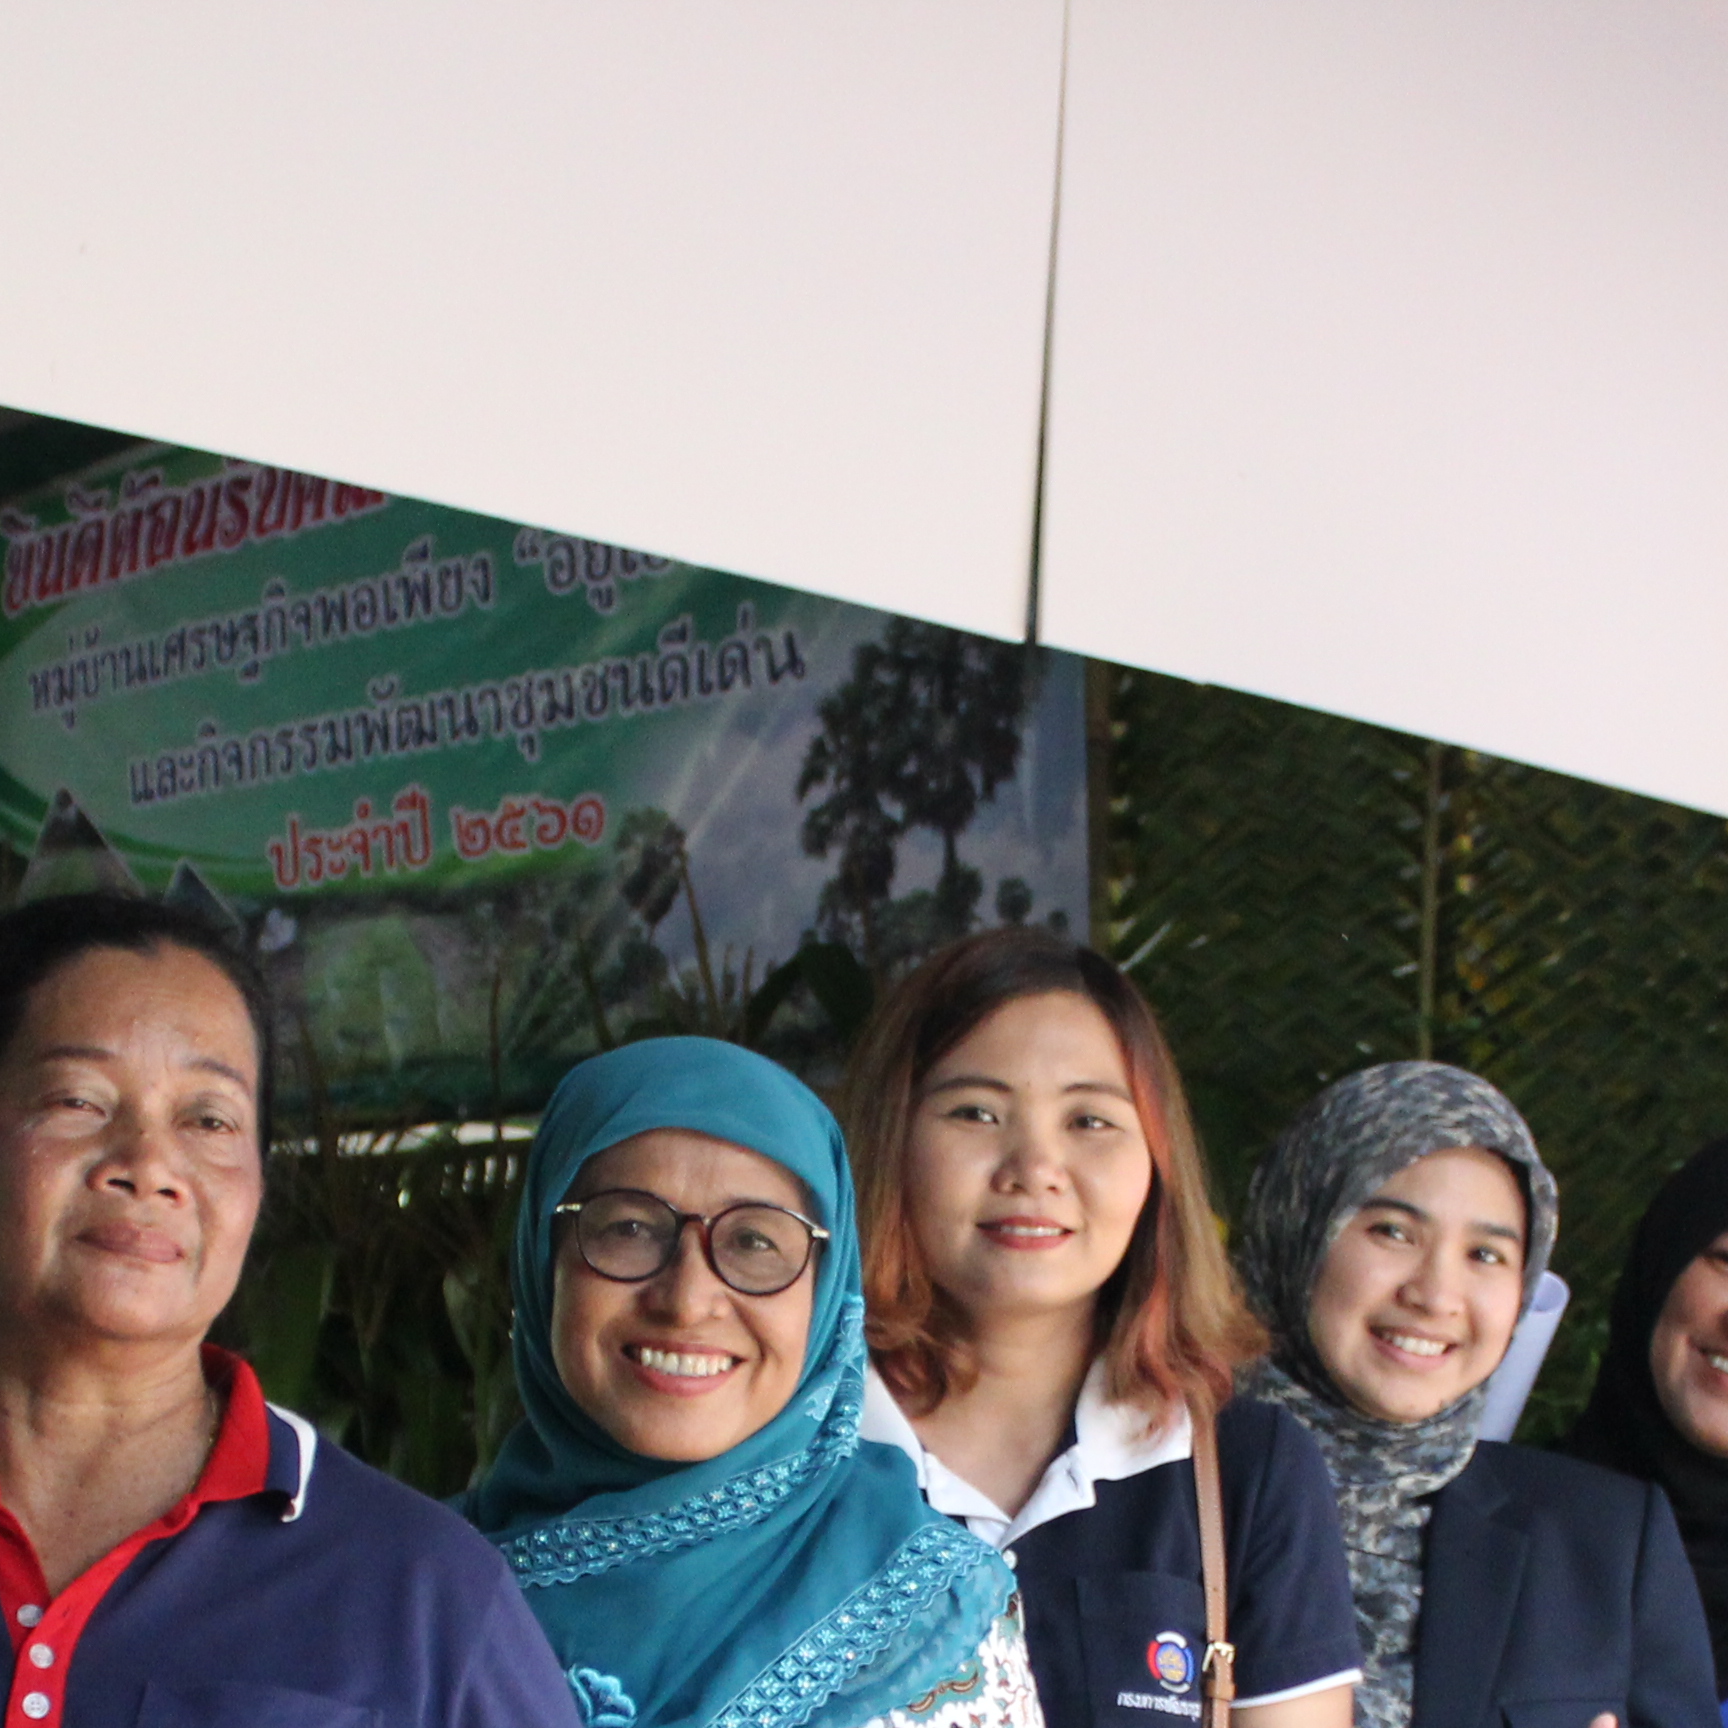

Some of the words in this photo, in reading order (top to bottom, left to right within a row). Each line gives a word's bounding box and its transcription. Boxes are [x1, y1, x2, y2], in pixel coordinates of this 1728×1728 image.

[28, 541, 494, 729] หมู่บ้านเศรษฐกิจพอเพียง
[129, 606, 805, 804] และกิจกรรมพัฒนาชุมชนดีเด่น
[270, 790, 432, 888] ประจำปี
[455, 798, 605, 858] ๒๕๖๑
